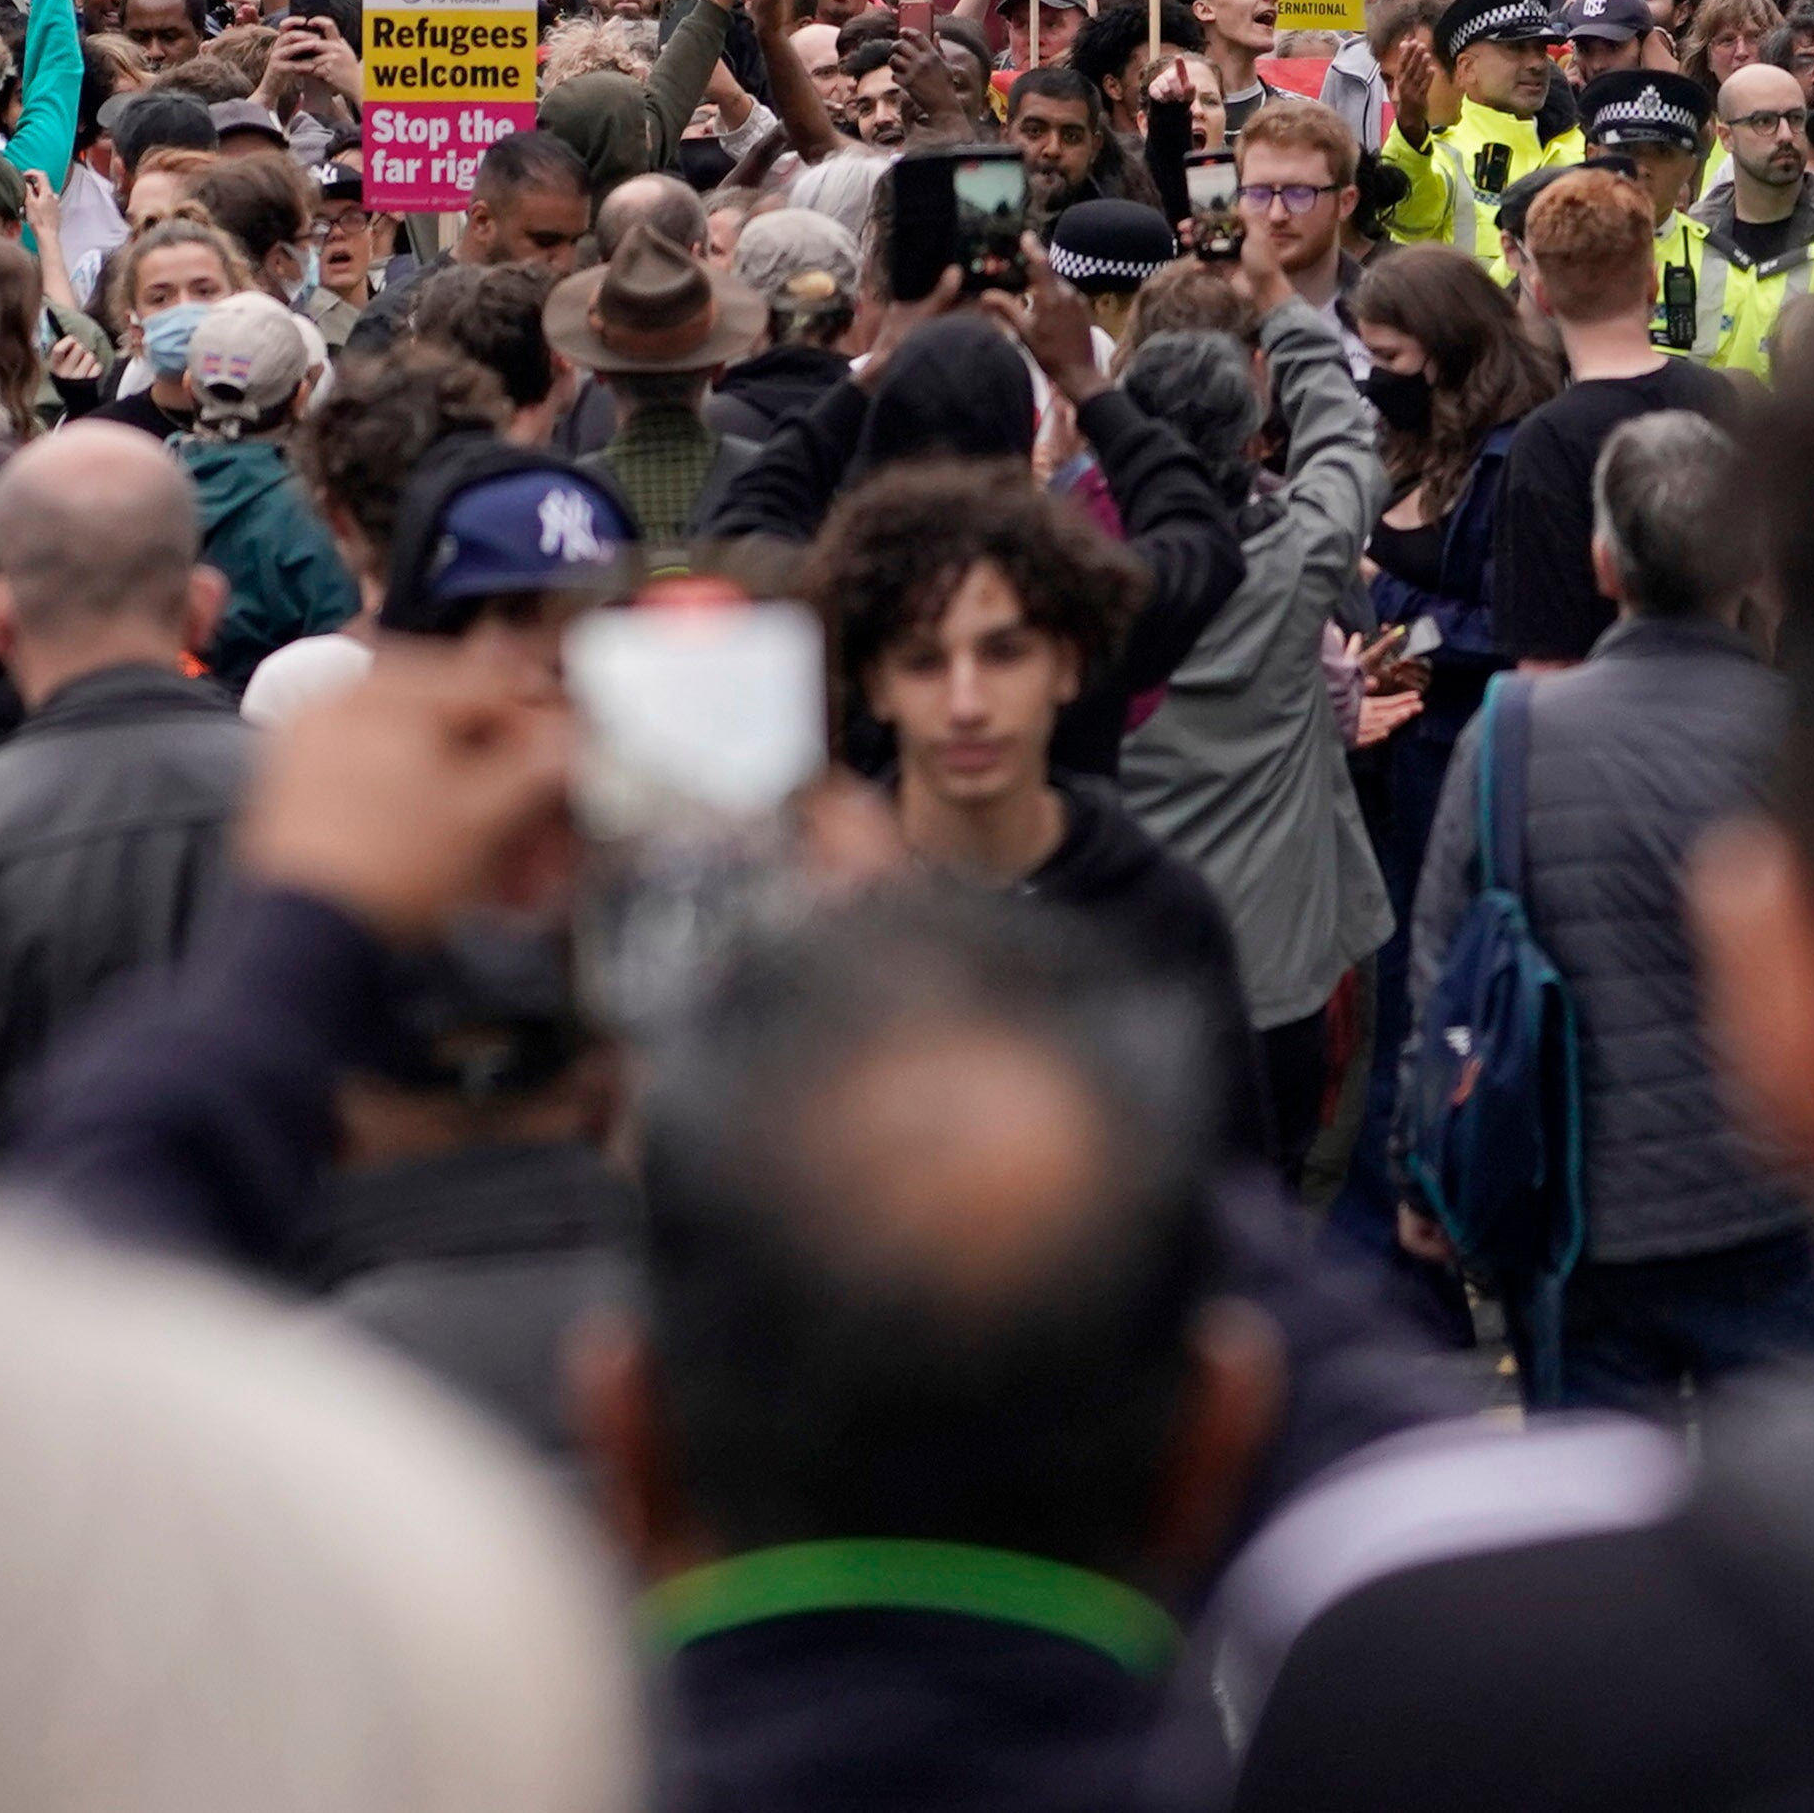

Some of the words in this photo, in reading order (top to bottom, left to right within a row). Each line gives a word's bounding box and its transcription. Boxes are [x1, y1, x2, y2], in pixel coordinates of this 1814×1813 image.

[373, 18, 528, 55] Refugees
[373, 57, 520, 88] welcome
[371, 108, 450, 151] Stop
[458, 110, 515, 143] the
[371, 149, 422, 184] far
[431, 149, 486, 191] rig
